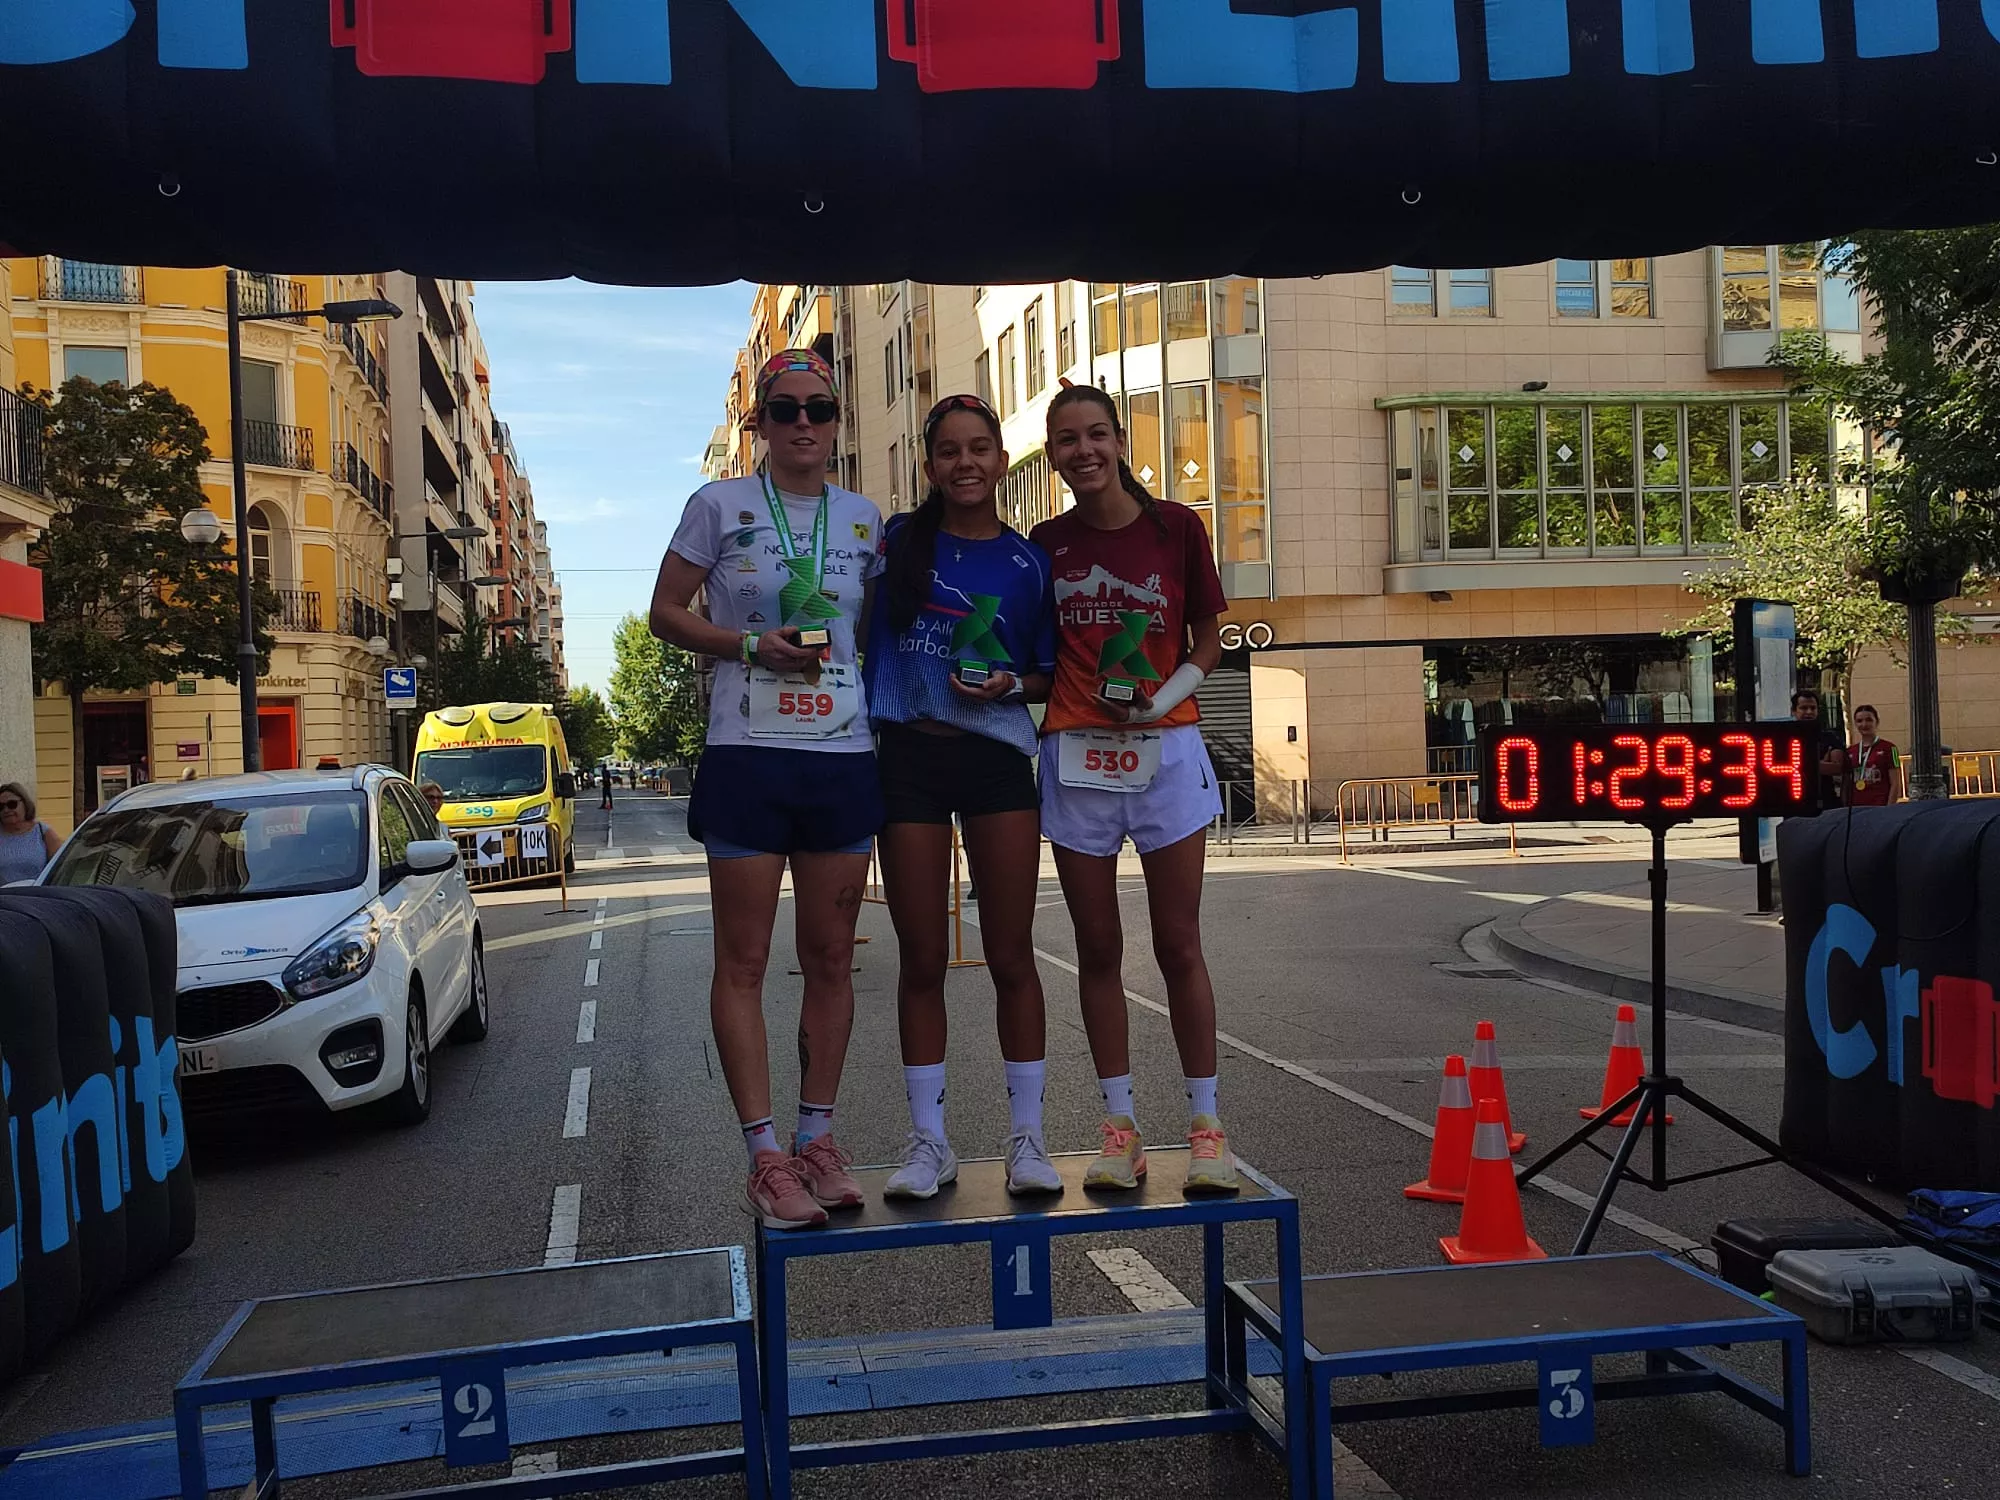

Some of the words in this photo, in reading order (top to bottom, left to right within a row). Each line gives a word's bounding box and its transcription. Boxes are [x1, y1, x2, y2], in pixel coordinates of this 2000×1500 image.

[1219, 622, 1273, 650] GO
[778, 693, 834, 716] 559
[1085, 750, 1139, 772] 530
[523, 831, 545, 849] 10K
[182, 1052, 213, 1073] NL
[1007, 1244, 1034, 1296] 1
[1549, 1369, 1585, 1419] 3
[454, 1383, 496, 1438] 2
